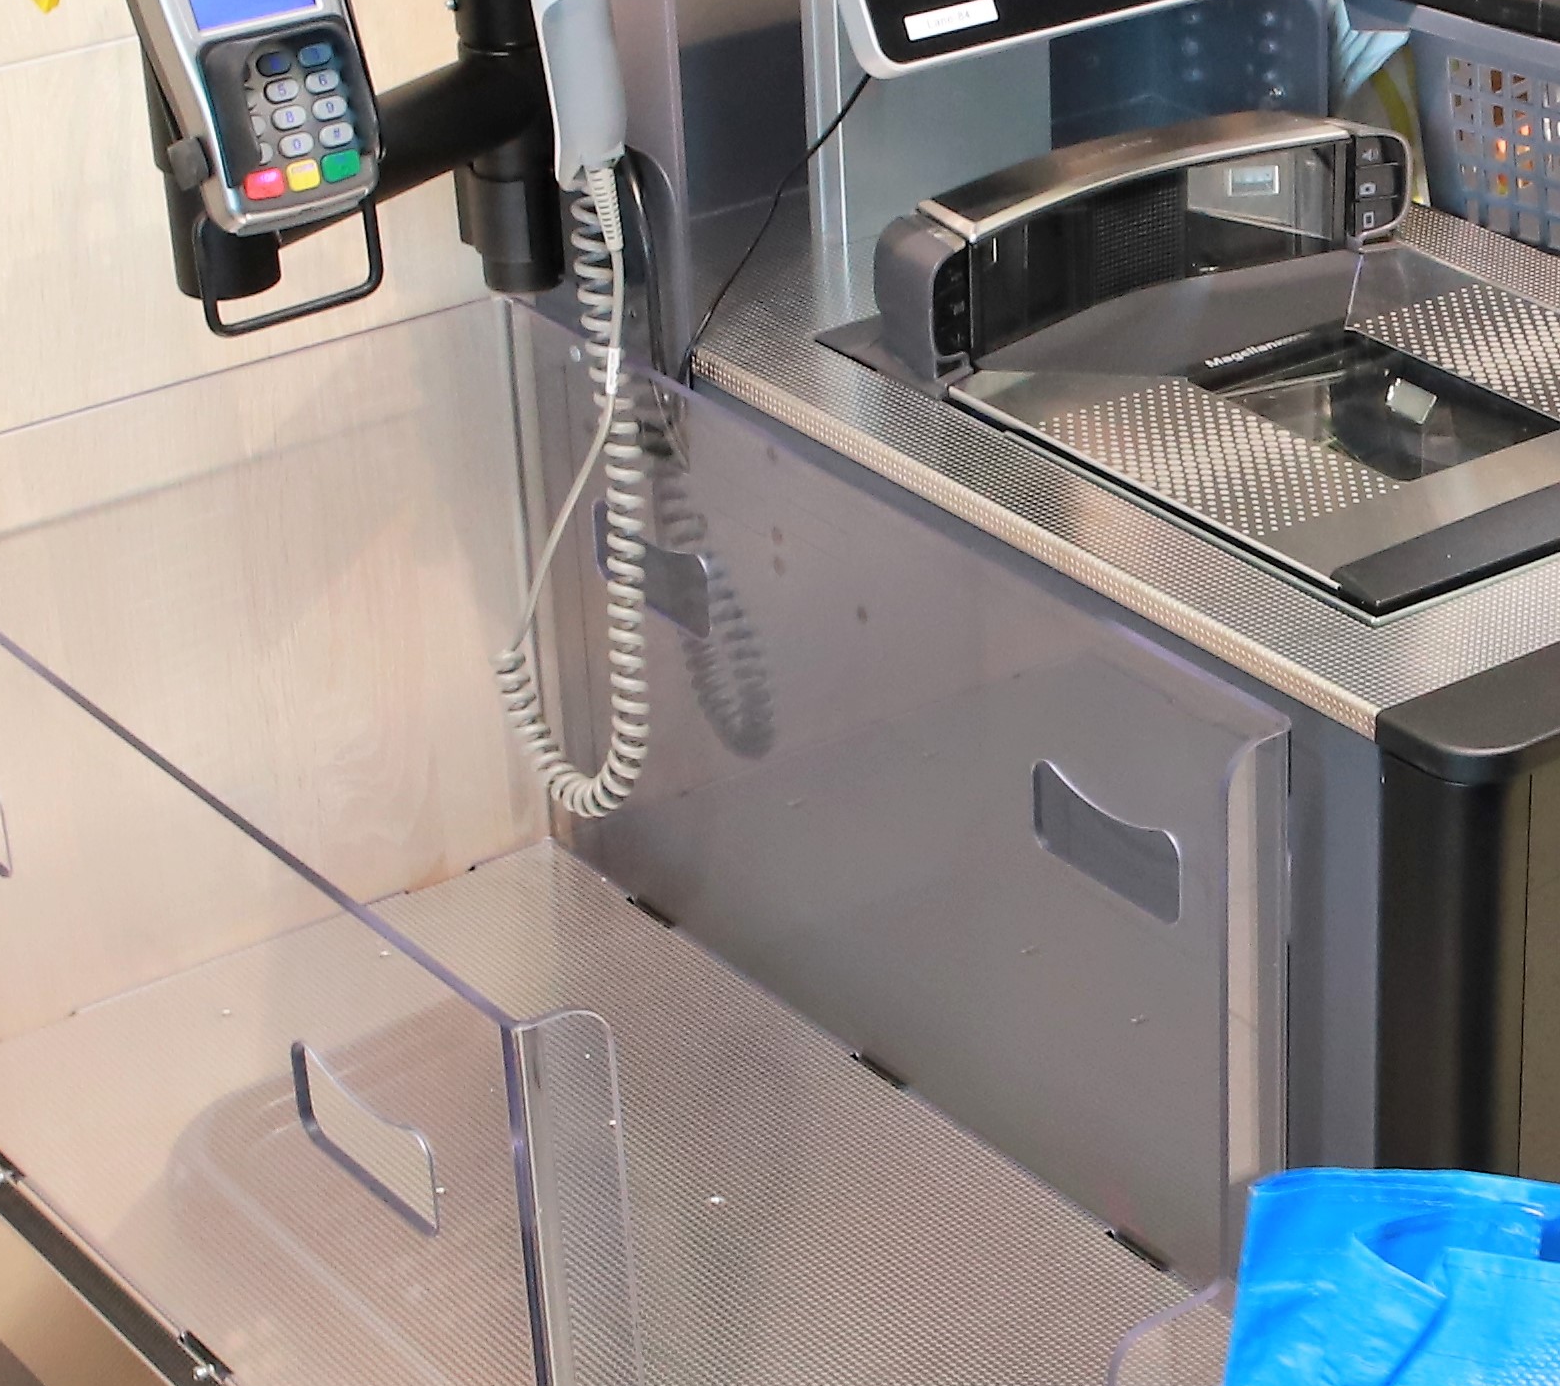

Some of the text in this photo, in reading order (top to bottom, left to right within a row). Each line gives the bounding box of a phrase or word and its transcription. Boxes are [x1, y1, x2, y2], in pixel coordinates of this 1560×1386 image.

[318, 73, 328, 87] 6
[277, 83, 287, 97] 5
[1204, 341, 1278, 369] Magellan
